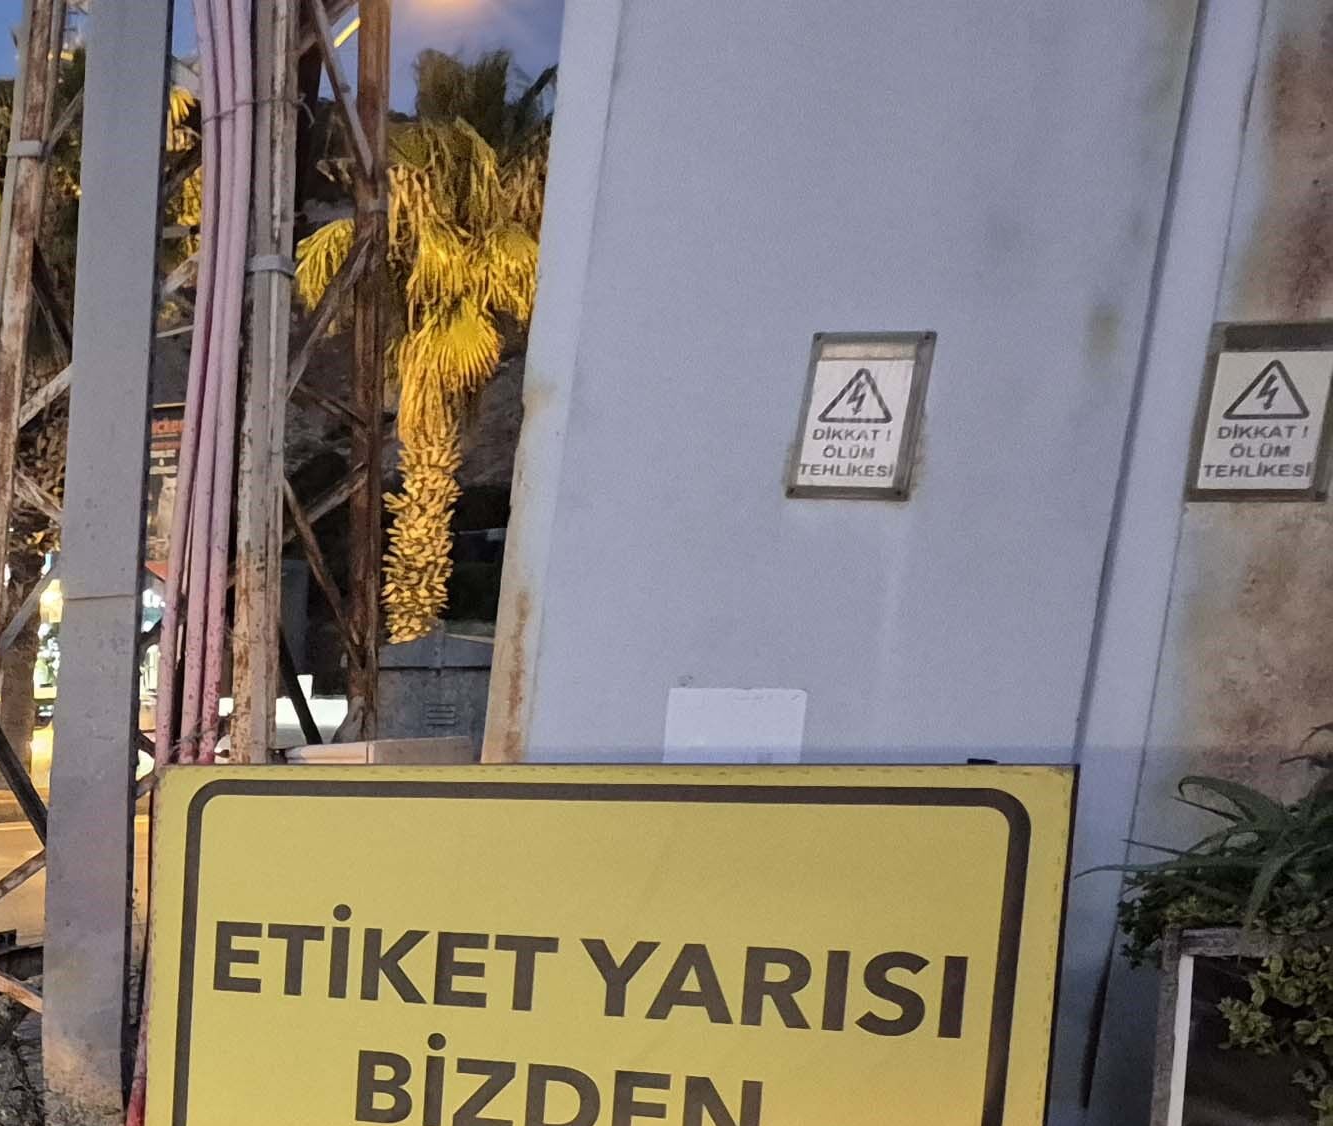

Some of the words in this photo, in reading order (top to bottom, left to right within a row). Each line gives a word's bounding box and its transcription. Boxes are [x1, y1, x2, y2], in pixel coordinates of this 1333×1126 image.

[812, 425, 881, 441] DİKKAT
[1217, 423, 1297, 439] DİKKAT
[822, 444, 876, 459] ÖLÜM
[1229, 442, 1291, 459] ÖLÜM
[1203, 461, 1314, 478] TEHLİKESİ
[212, 902, 559, 1012] ETİKET
[579, 938, 969, 1040] YARISI
